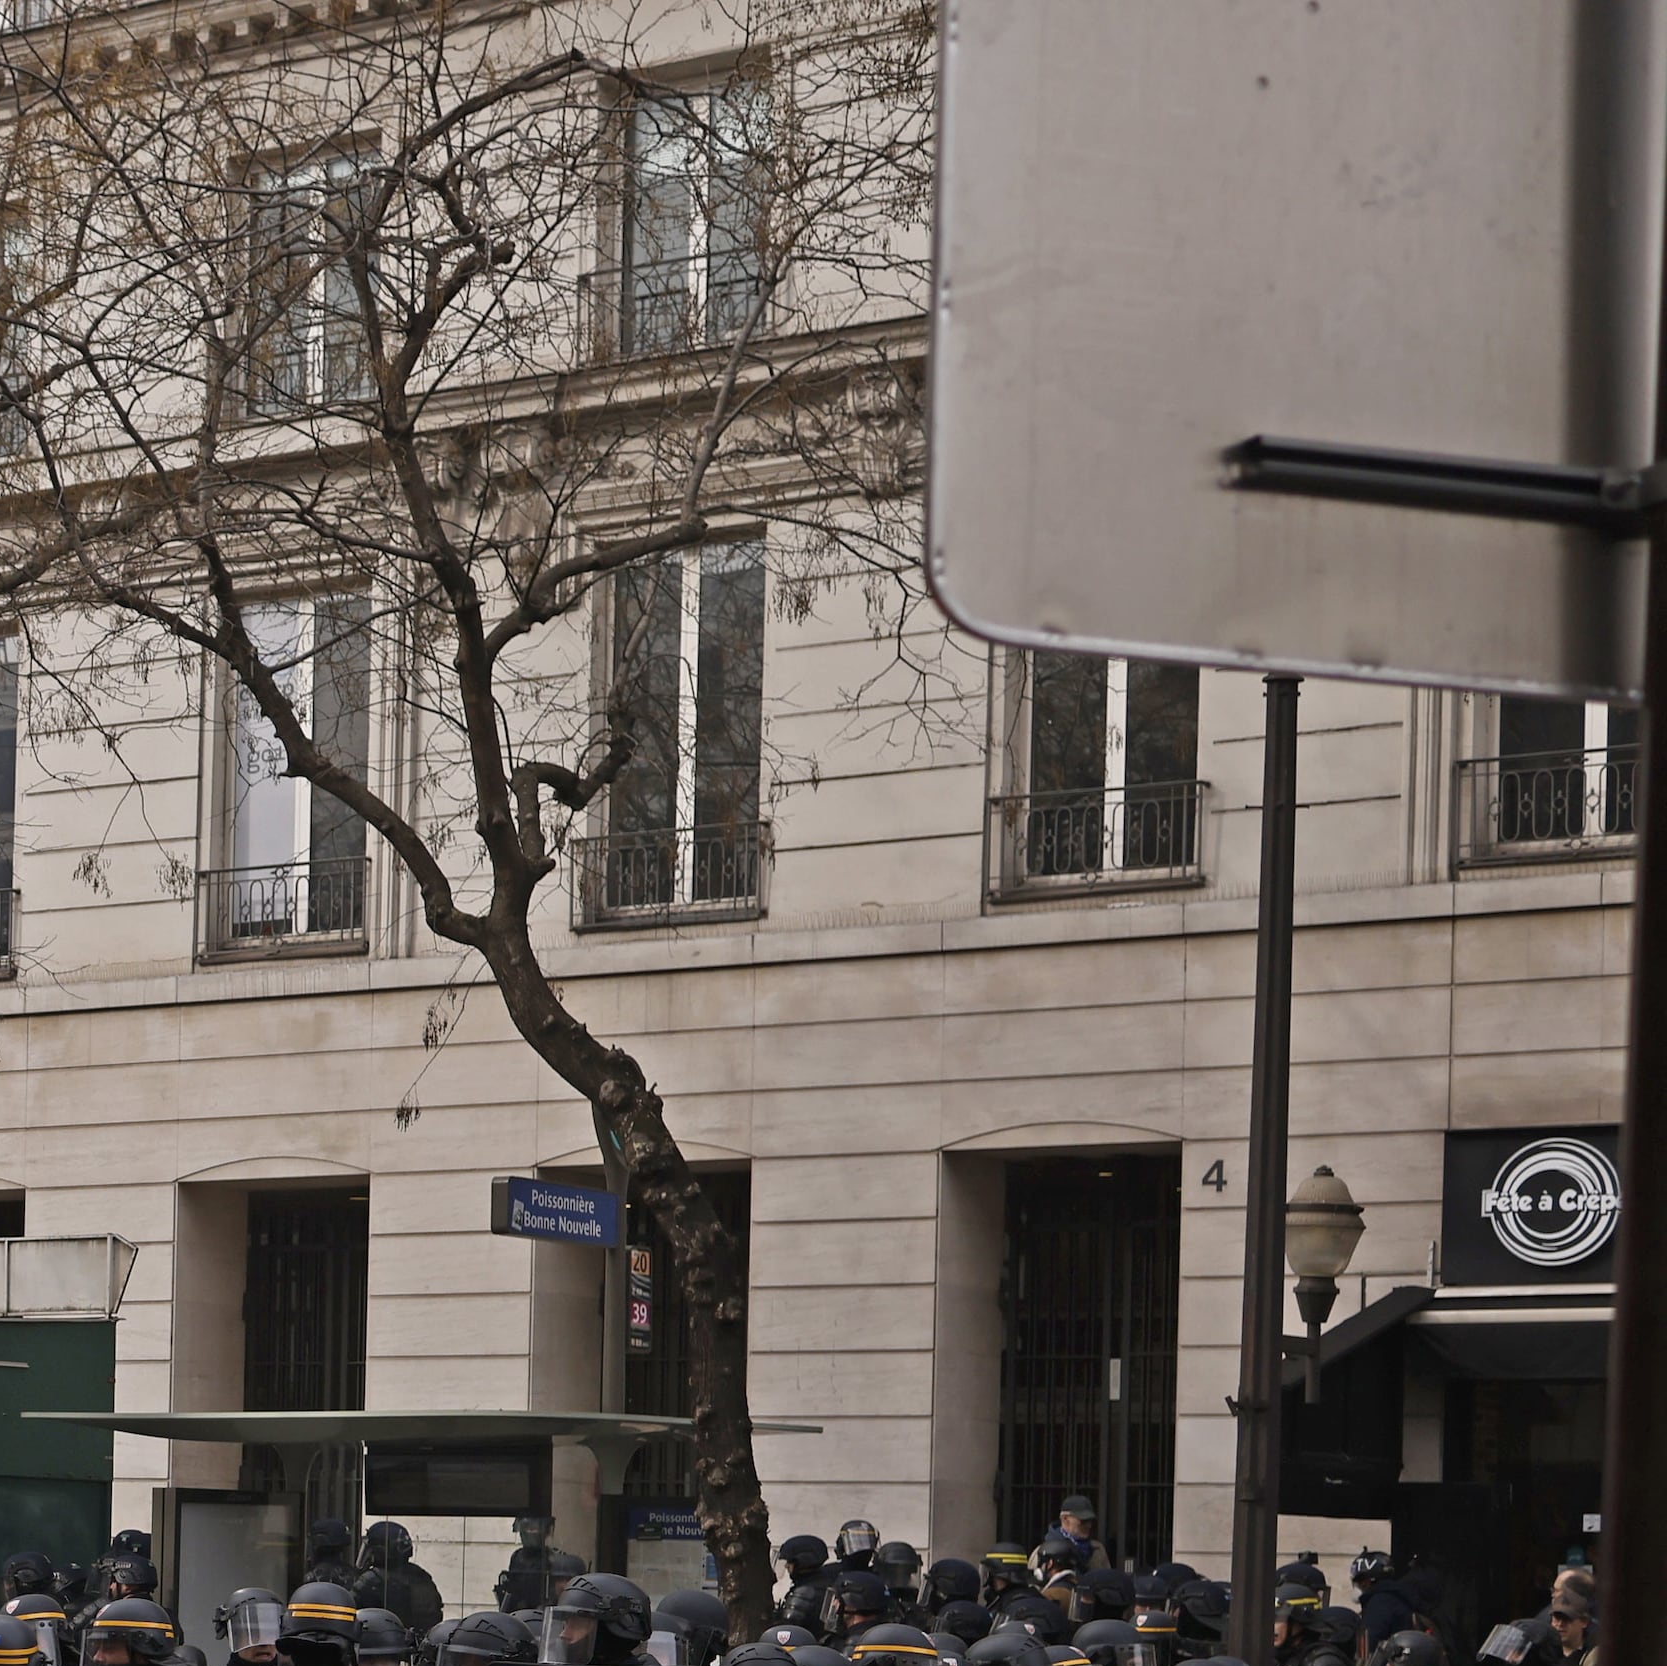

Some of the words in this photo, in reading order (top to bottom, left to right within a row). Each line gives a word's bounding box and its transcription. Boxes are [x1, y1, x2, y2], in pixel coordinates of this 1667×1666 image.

[1202, 1159, 1228, 1193] 4
[531, 1189, 595, 1214] Poissonnière
[1538, 1189, 1553, 1211] à
[524, 1212, 556, 1232] Bonne
[558, 1215, 602, 1238] Nouvelle
[633, 1252, 647, 1274] 20
[632, 1303, 648, 1324] 39
[649, 1511, 700, 1523] Poissonni
[676, 1525, 706, 1537] Nouv
[1355, 1558, 1378, 1572] TV
